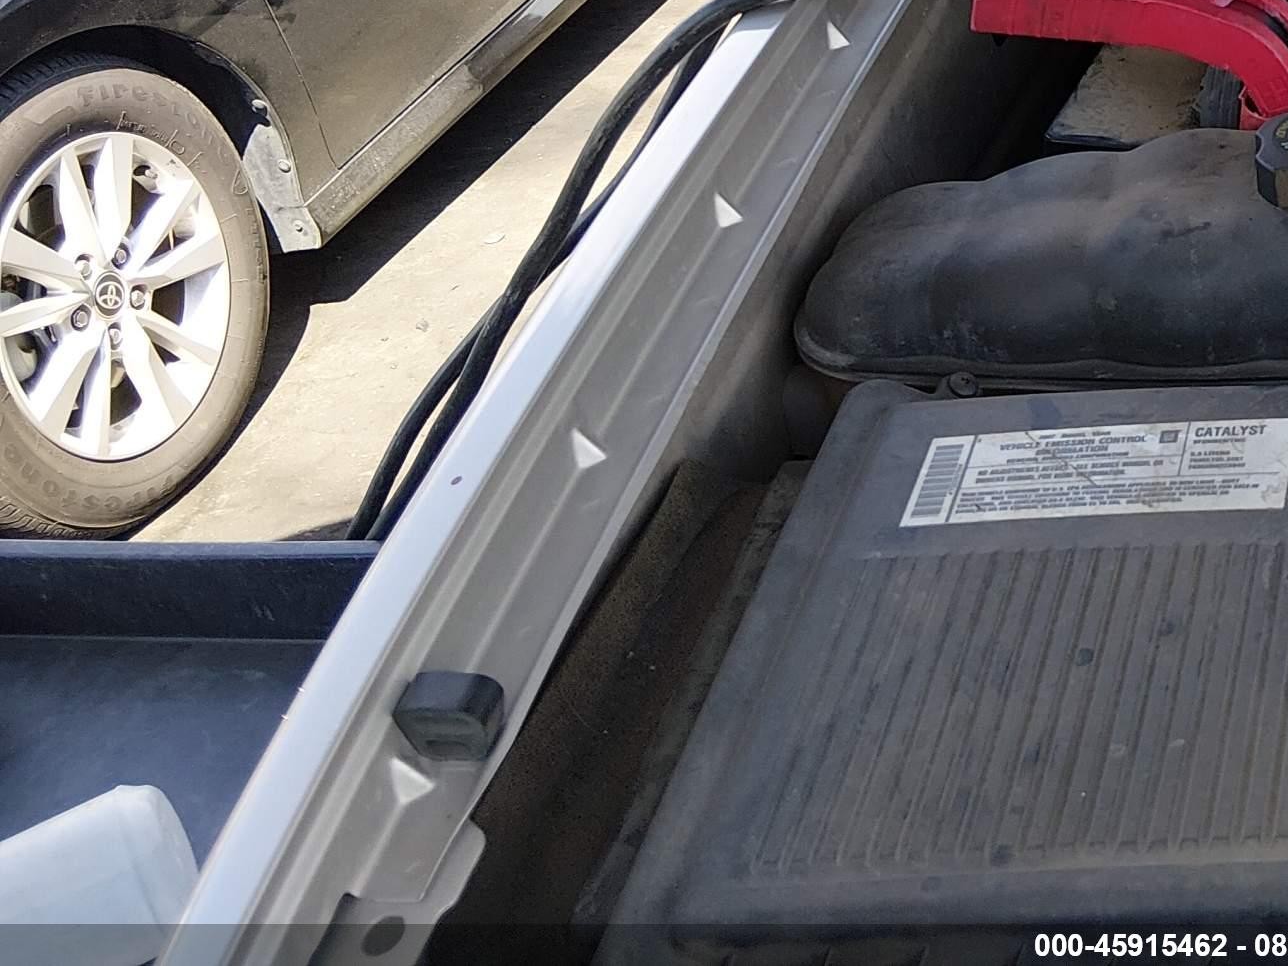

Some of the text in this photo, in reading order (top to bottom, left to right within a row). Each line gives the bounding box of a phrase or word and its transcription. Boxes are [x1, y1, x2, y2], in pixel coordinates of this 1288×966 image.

[1195, 425, 1267, 437] CATALYST
[1000, 435, 1147, 451] VEHICLE EMISSION CONTROL
